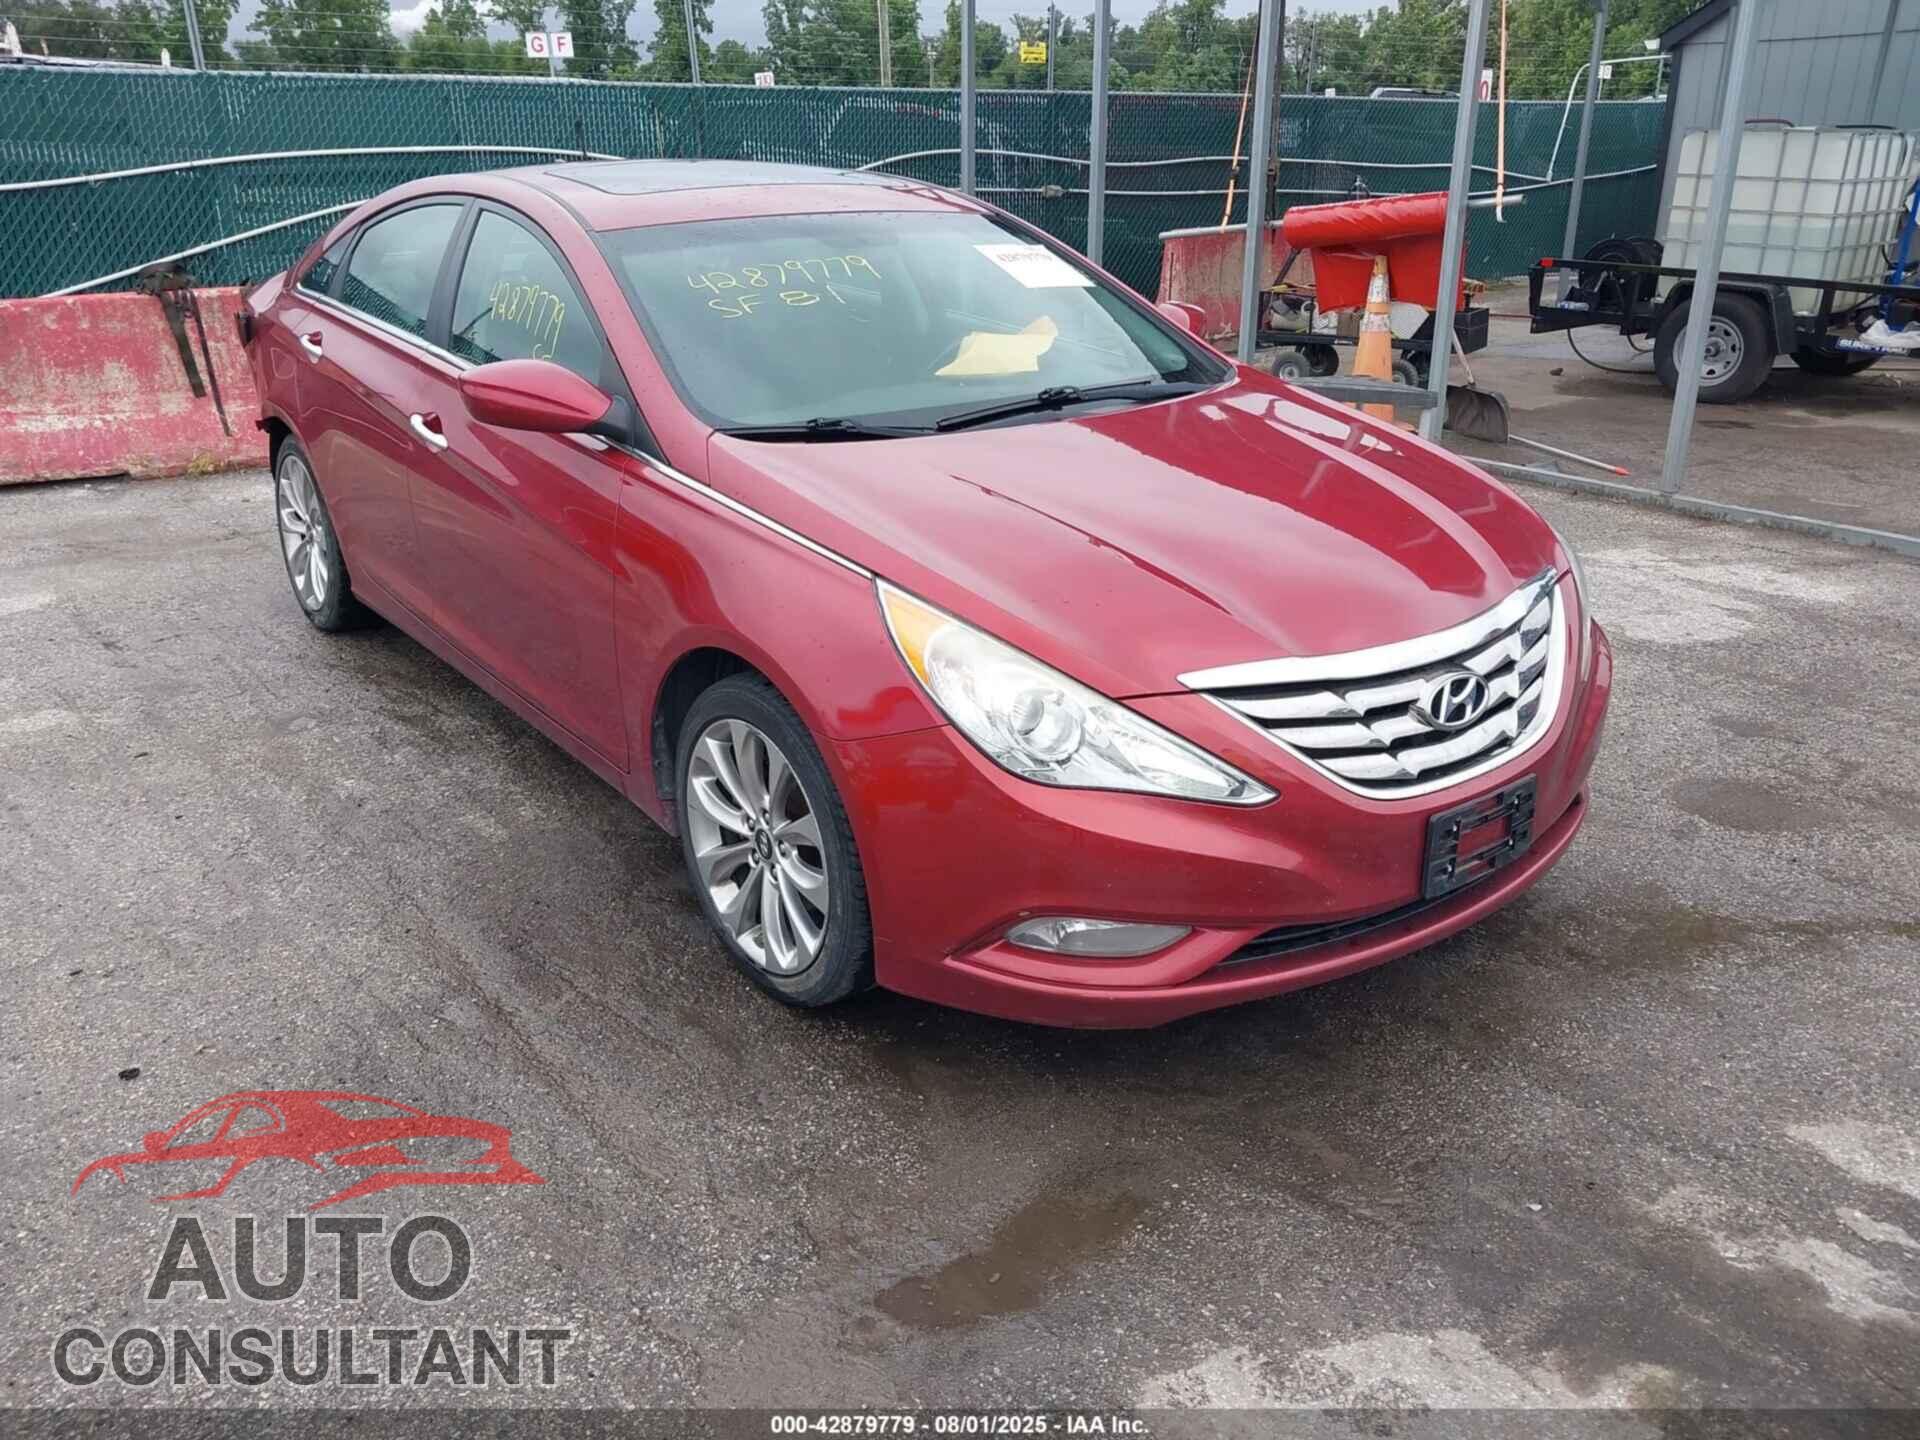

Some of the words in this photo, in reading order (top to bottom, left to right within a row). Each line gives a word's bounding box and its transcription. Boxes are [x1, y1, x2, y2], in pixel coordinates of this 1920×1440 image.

[531, 36, 545, 53] G
[556, 36, 566, 53] F
[687, 255, 882, 294] 42879779
[489, 280, 565, 358] 42879779
[708, 294, 763, 319] SF
